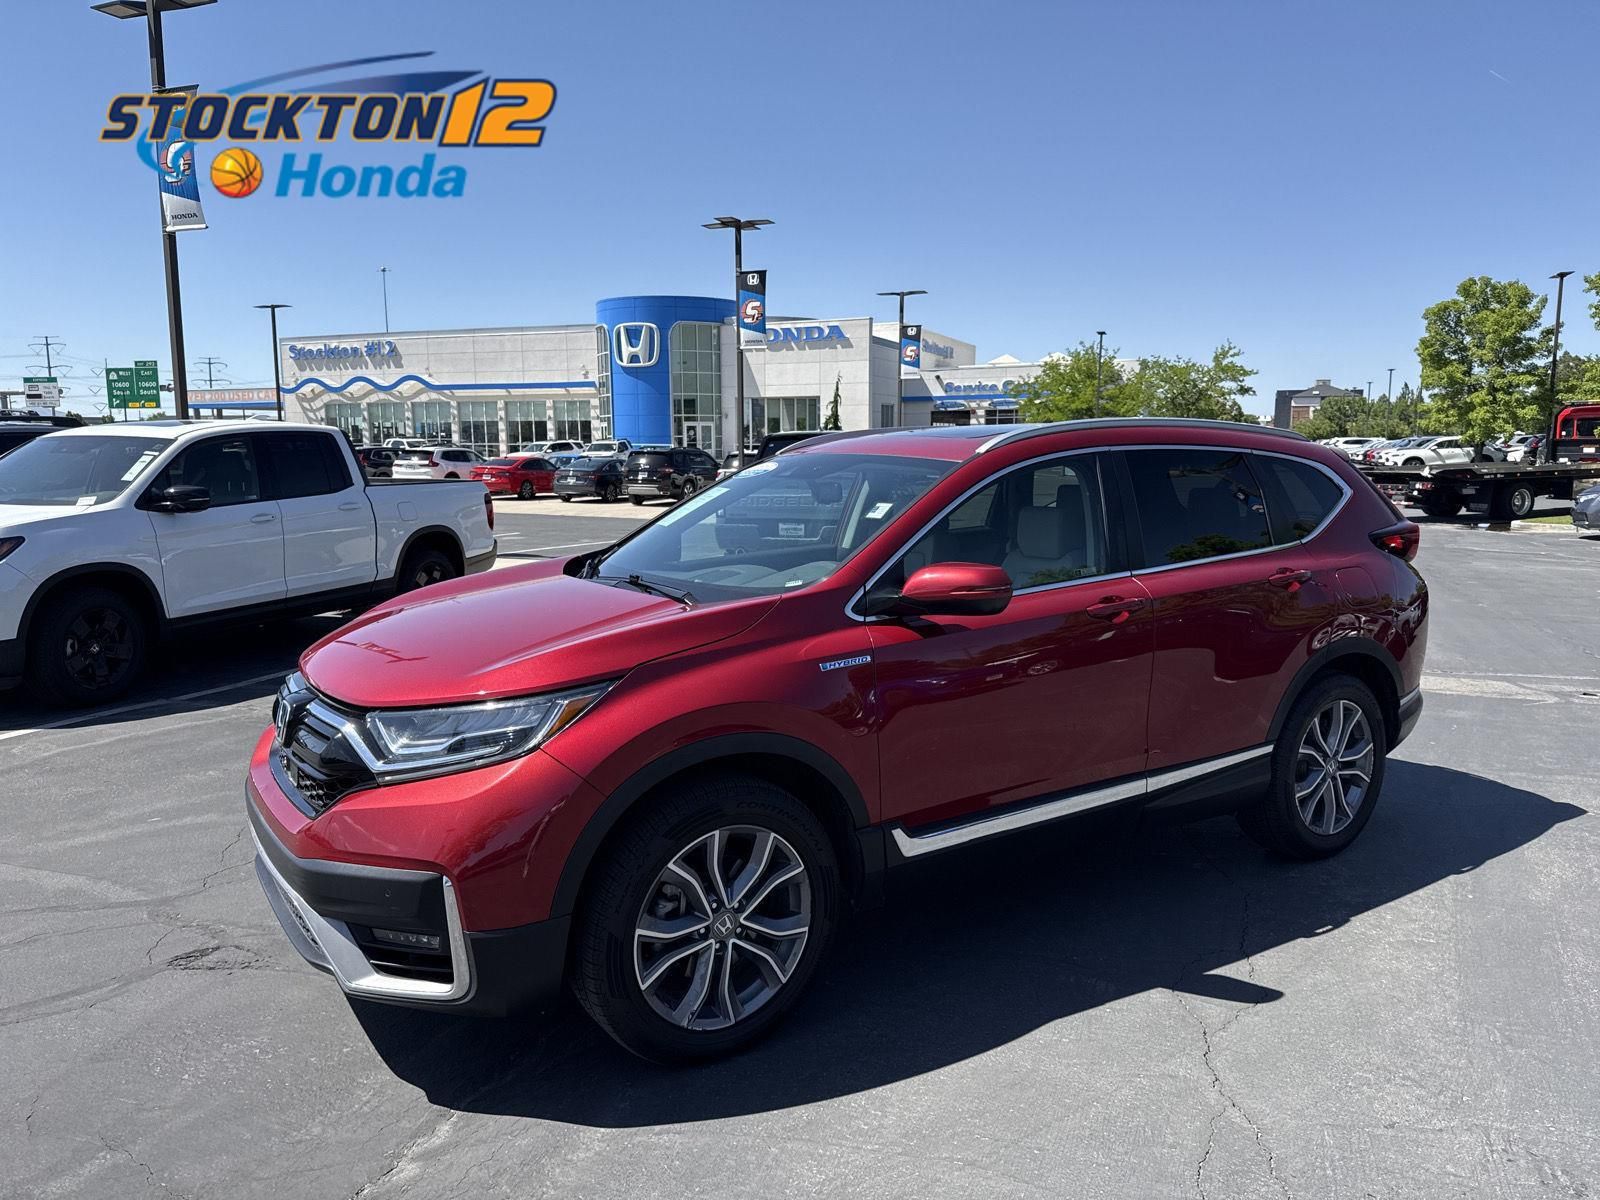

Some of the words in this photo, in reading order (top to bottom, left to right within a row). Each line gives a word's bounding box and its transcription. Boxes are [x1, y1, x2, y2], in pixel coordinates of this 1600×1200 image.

[171, 212, 198, 220] HONDA
[766, 325, 849, 343] ONDA
[288, 343, 362, 359] Stockton
[364, 340, 398, 358] #12
[944, 380, 998, 393] Service
[187, 391, 205, 400] VER
[207, 391, 226, 400] 200
[228, 391, 254, 400] USED
[257, 390, 277, 400] CAR
[828, 656, 868, 669] HYBRID
